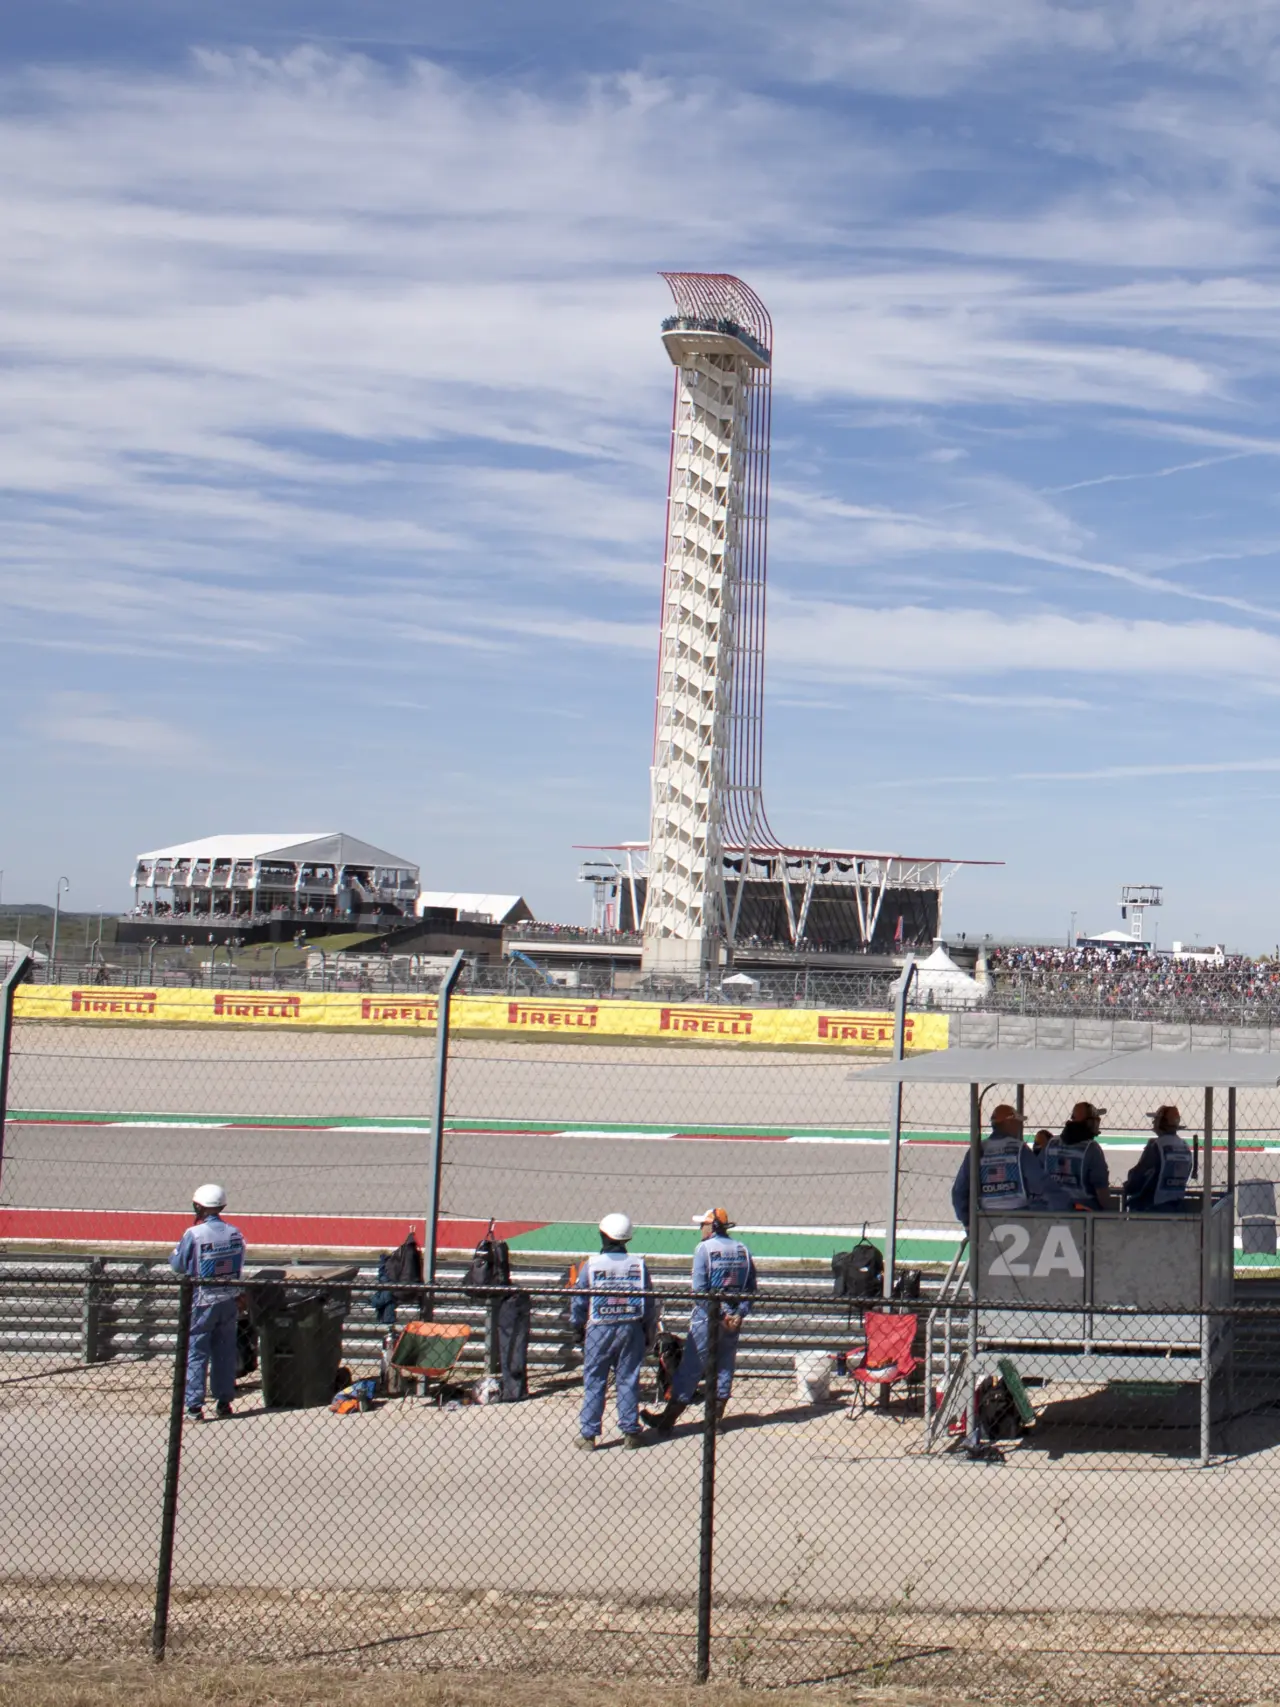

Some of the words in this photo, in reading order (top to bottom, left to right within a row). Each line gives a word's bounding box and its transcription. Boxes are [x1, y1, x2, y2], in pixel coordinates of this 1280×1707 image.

[71, 991, 157, 1013] PIRELLI
[214, 994, 301, 1018] PIRELLI
[362, 998, 438, 1020] PIRELL
[508, 1002, 598, 1026] PIRELLI
[660, 1008, 753, 1034] PIRELLI
[818, 1016, 914, 1041] PIRELI
[988, 1224, 1084, 1277] 2A
